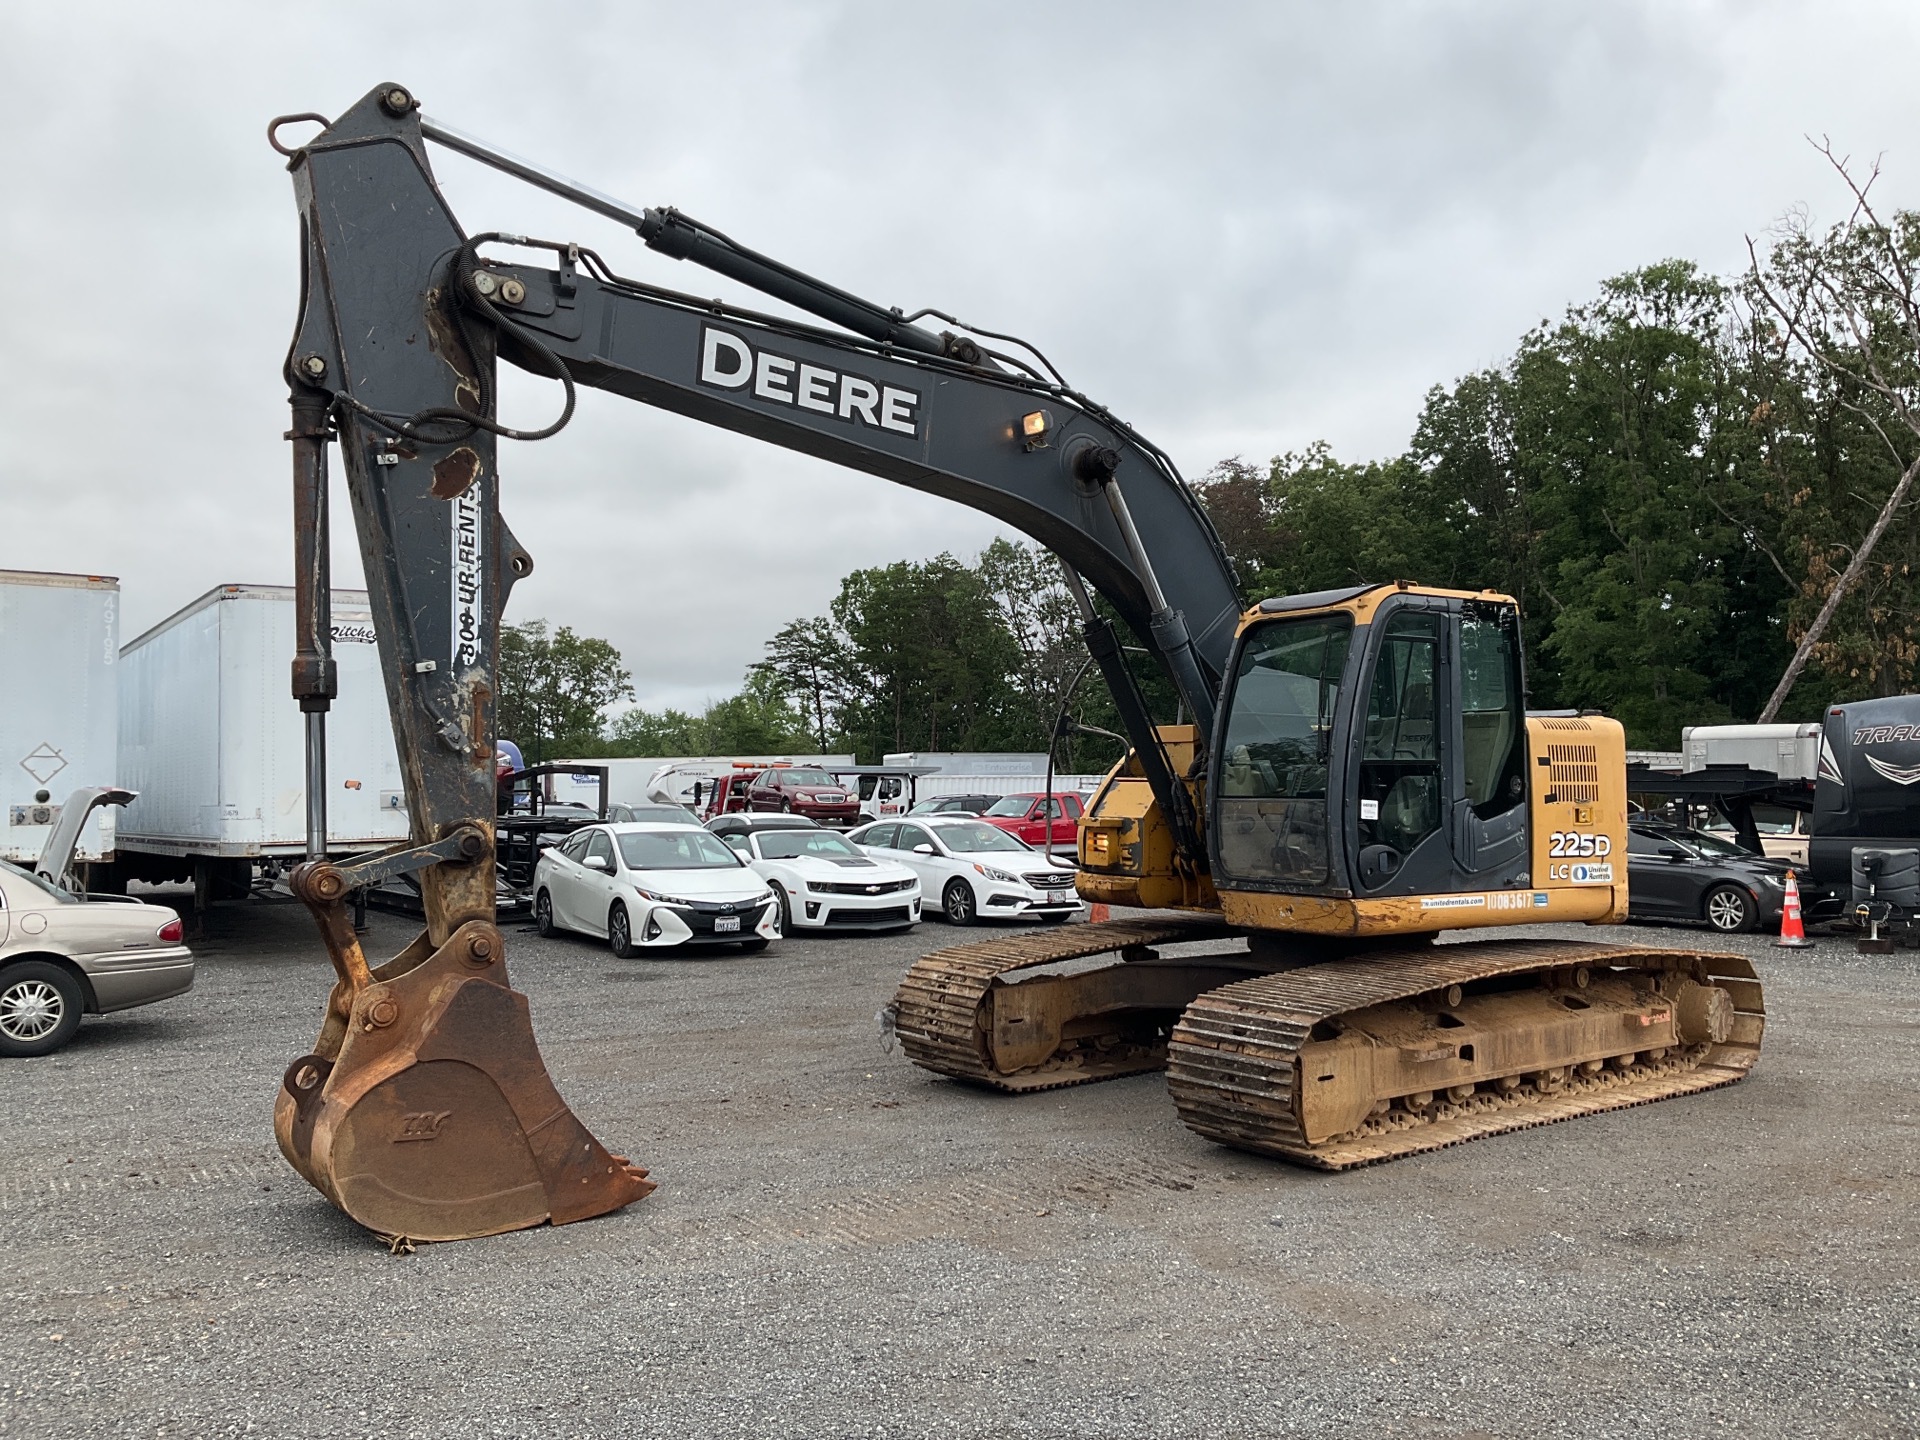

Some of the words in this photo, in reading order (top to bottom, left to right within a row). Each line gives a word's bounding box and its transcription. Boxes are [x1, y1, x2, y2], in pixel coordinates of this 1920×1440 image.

[702, 327, 917, 434] DEERE
[103, 596, 115, 665] 49195
[985, 763, 1031, 771] Enterprise
[1549, 831, 1611, 858] 225D
[1550, 864, 1569, 880] LC
